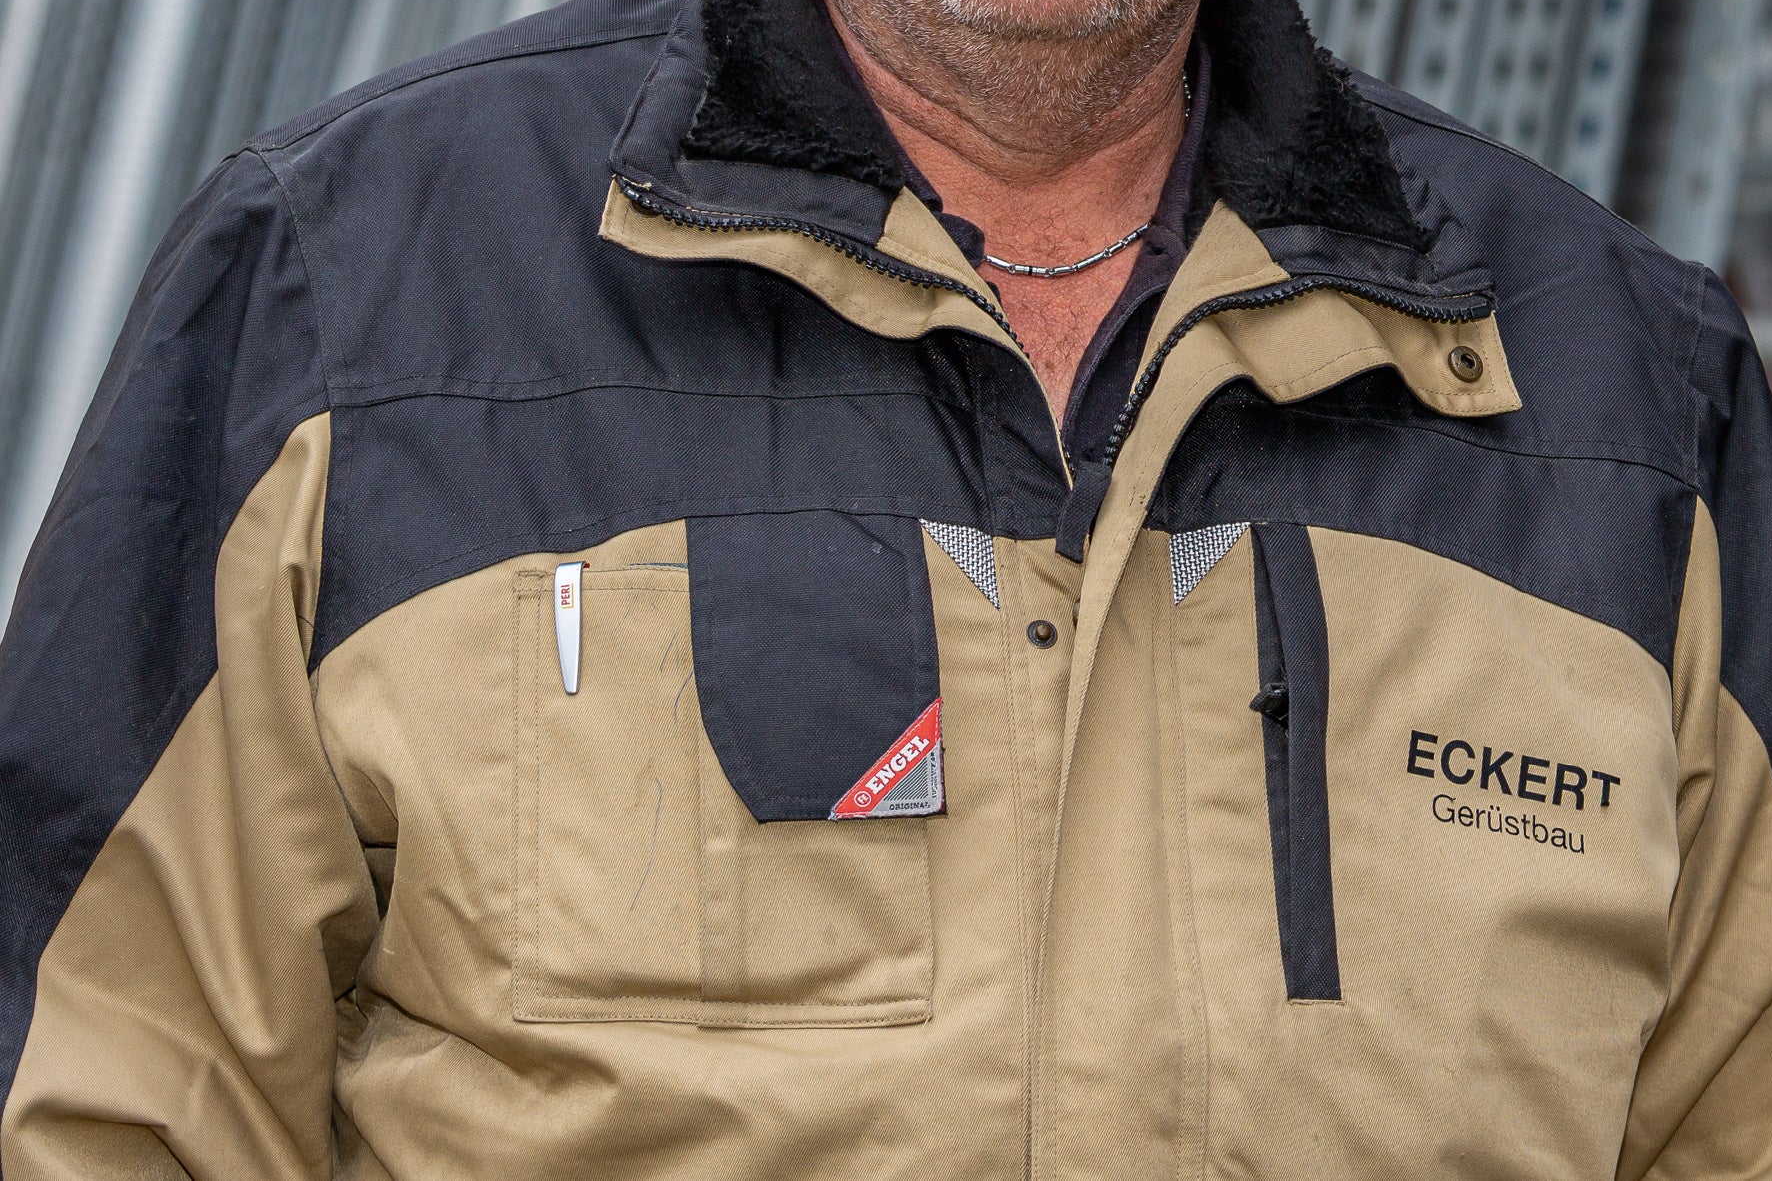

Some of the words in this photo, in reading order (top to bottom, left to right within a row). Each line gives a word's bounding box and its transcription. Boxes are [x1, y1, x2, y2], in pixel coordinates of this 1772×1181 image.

[561, 584, 571, 606] PERI
[865, 735, 930, 795] ENGEL
[1407, 729, 1621, 811] ECKERT
[889, 801, 931, 811] ORIGINAL
[1432, 793, 1586, 855] Gerüstbau
